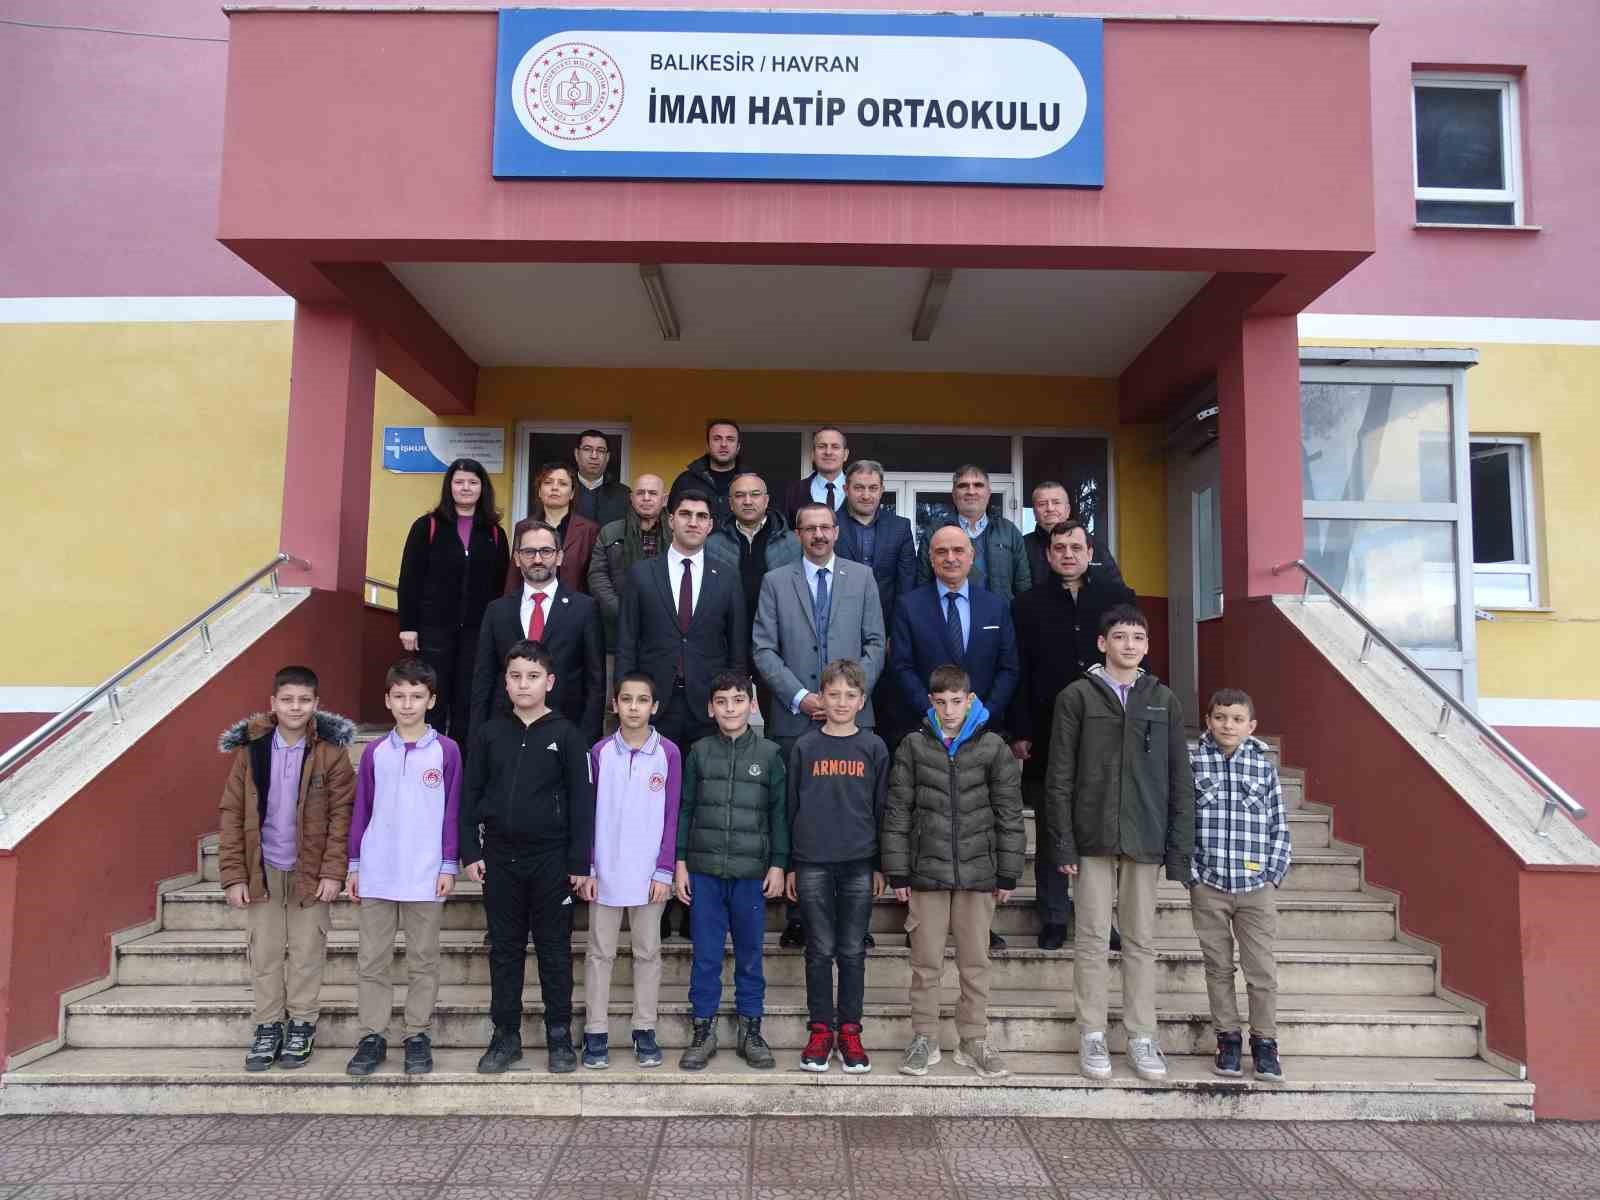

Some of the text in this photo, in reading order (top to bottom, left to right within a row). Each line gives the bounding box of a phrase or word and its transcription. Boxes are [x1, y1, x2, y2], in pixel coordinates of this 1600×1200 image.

[650, 51, 859, 73] BALIKESİR / HAVRAN
[649, 87, 1060, 131] İMAM HATİP ORTAOKULU
[812, 759, 865, 778] ARMOUR
